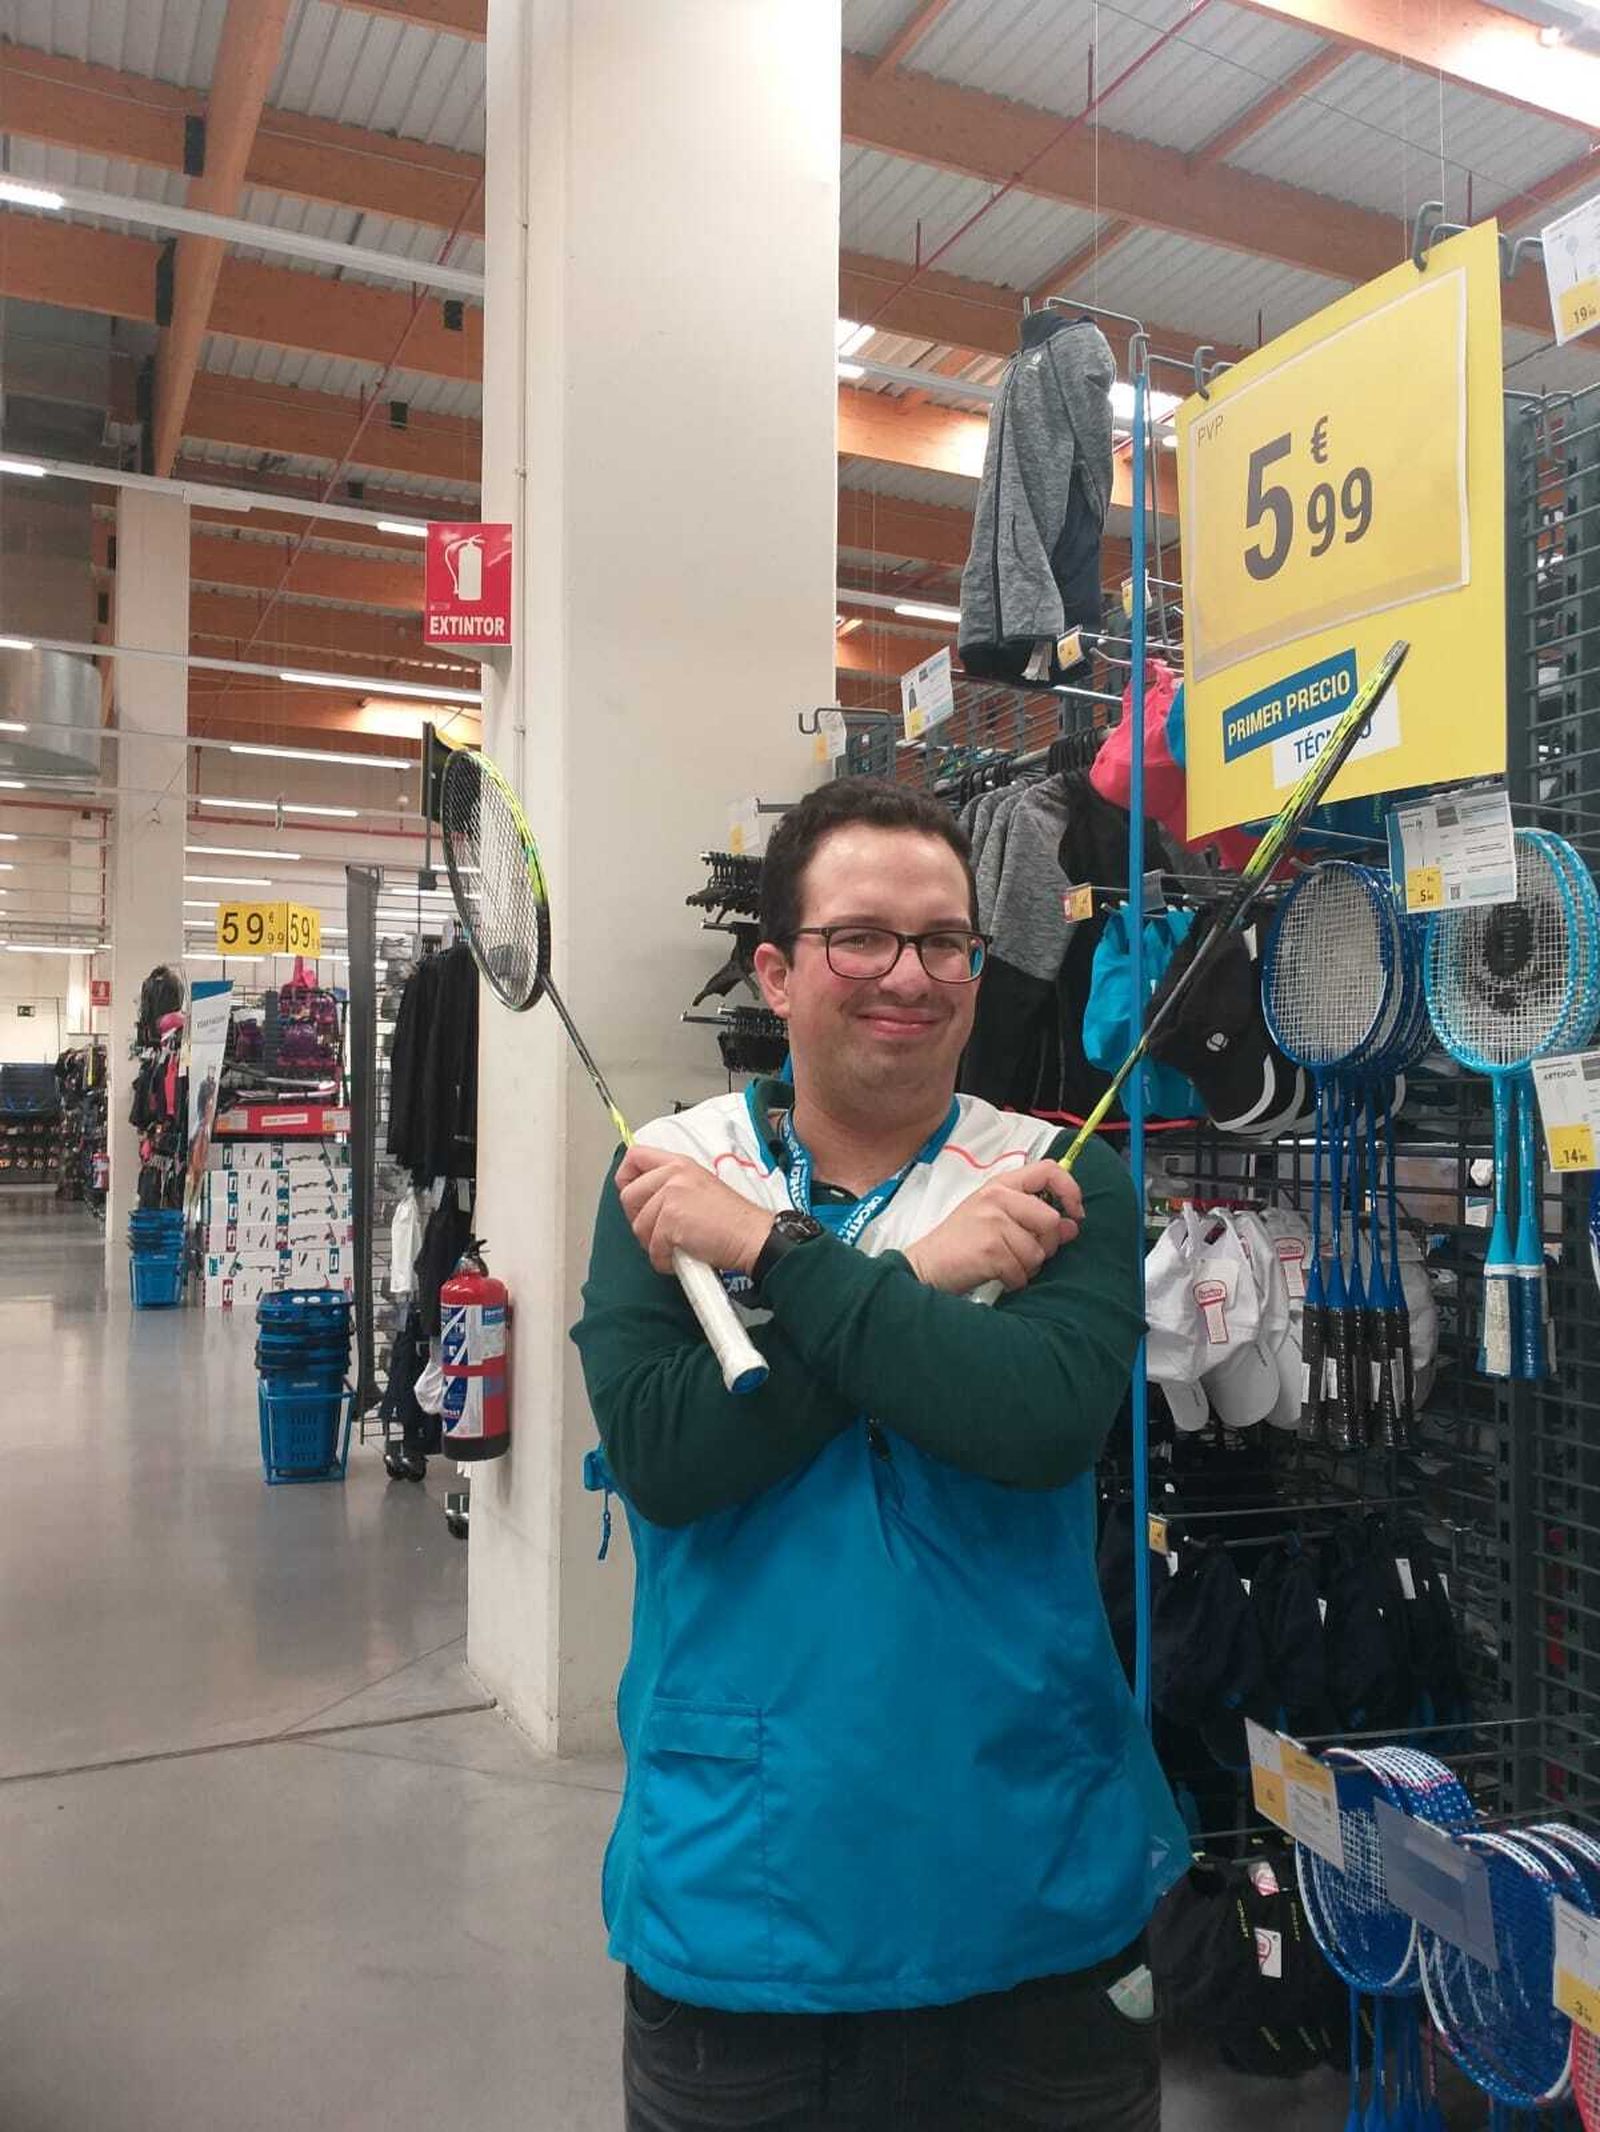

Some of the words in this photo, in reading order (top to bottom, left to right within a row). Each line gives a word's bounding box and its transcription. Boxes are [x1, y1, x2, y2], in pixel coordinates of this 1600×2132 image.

[1197, 415, 1224, 448] PVP
[1244, 432, 1294, 581] 5
[1307, 467, 1372, 557] 99
[429, 615, 505, 637] EXTINTOR
[1227, 700, 1283, 747] PRIMER
[1286, 670, 1351, 718] PRECIO
[222, 911, 264, 945] 59
